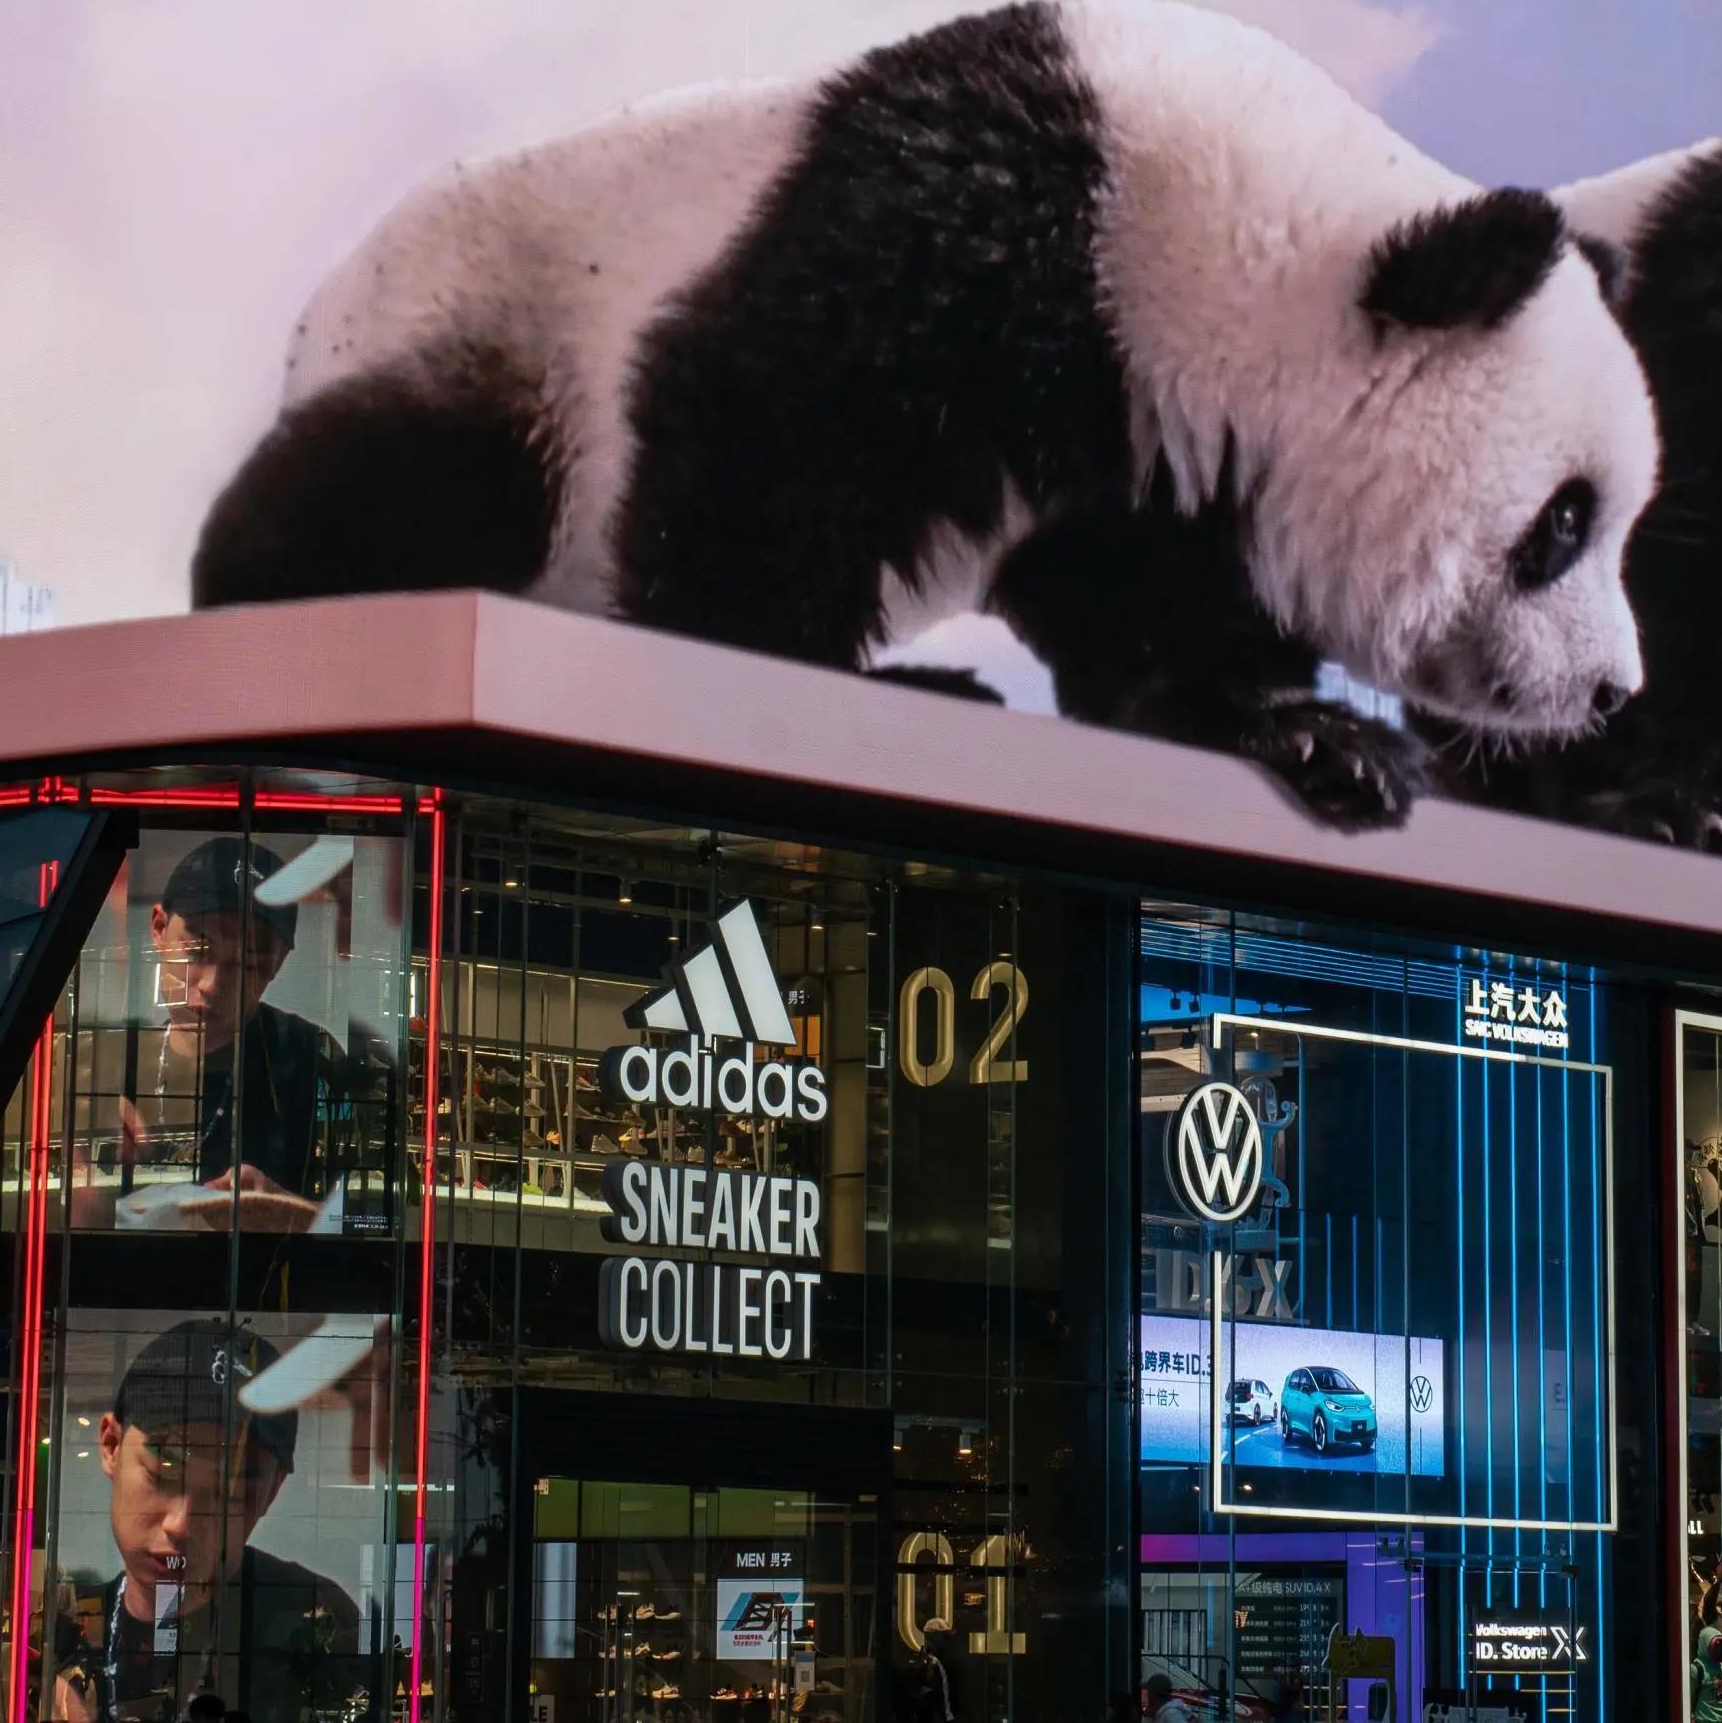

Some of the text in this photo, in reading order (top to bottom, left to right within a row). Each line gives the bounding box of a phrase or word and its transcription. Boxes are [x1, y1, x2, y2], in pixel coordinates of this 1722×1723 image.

[900, 962, 1029, 1087] 02
[1465, 978, 1568, 1028] 上汽大众
[619, 1033, 828, 1122] adidas
[620, 1161, 822, 1257] SNEAKER
[619, 1257, 822, 1360] COLLECT
[736, 1552, 792, 1568] MEN 男子
[897, 1531, 1027, 1655] 01
[1475, 1623, 1548, 1640] Volkswagen
[1475, 1642, 1499, 1660] ID.
[1501, 1641, 1548, 1660] Store
